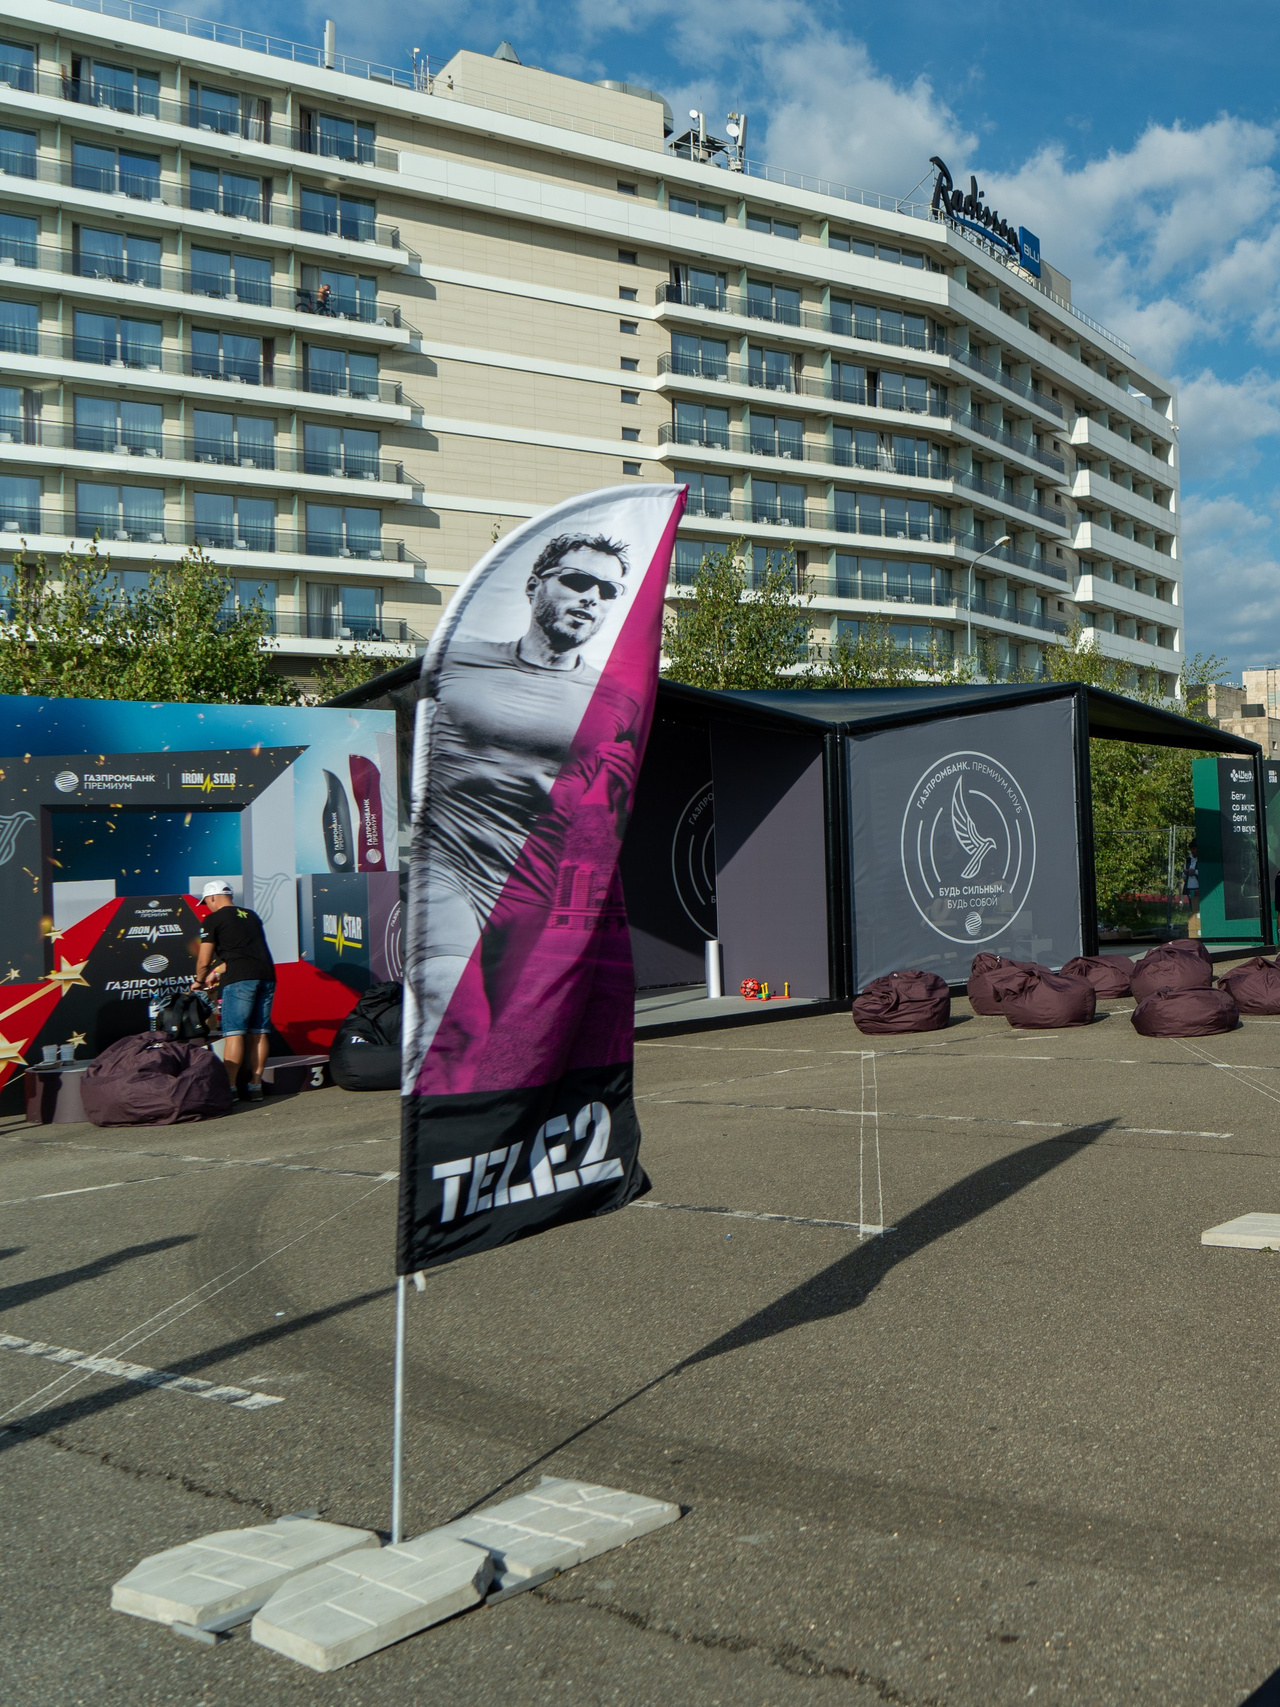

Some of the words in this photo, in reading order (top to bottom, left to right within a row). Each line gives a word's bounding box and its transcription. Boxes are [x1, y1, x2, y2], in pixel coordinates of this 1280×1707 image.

[929, 156, 1020, 252] Radisson
[1023, 243, 1040, 263] BLU
[84, 774, 156, 782] ГАЗПРОМБАНК
[84, 782, 132, 790] ПРЕМИУМ
[182, 773, 204, 784] IRON
[212, 773, 236, 784] STAR
[972, 762, 1008, 790] ПРЕМИУМ
[1006, 788, 1022, 814] КЛУБ
[688, 792, 714, 826] ГАЗПРО
[364, 798, 373, 846] ГАЗПРОМБАНК
[939, 886, 960, 897] БУДЬ
[962, 884, 1005, 896] СИЛЬНЫМ.
[947, 899, 968, 909] БУДЬ
[970, 895, 998, 907] СОБОЙ
[128, 926, 150, 935] IRON
[159, 924, 182, 933] STAR
[323, 914, 337, 937] IRON
[343, 916, 362, 940] STAR
[105, 975, 197, 990] ГАЗПРОМБАН
[310, 1066, 324, 1086] 3
[432, 1101, 624, 1224] TELE2
